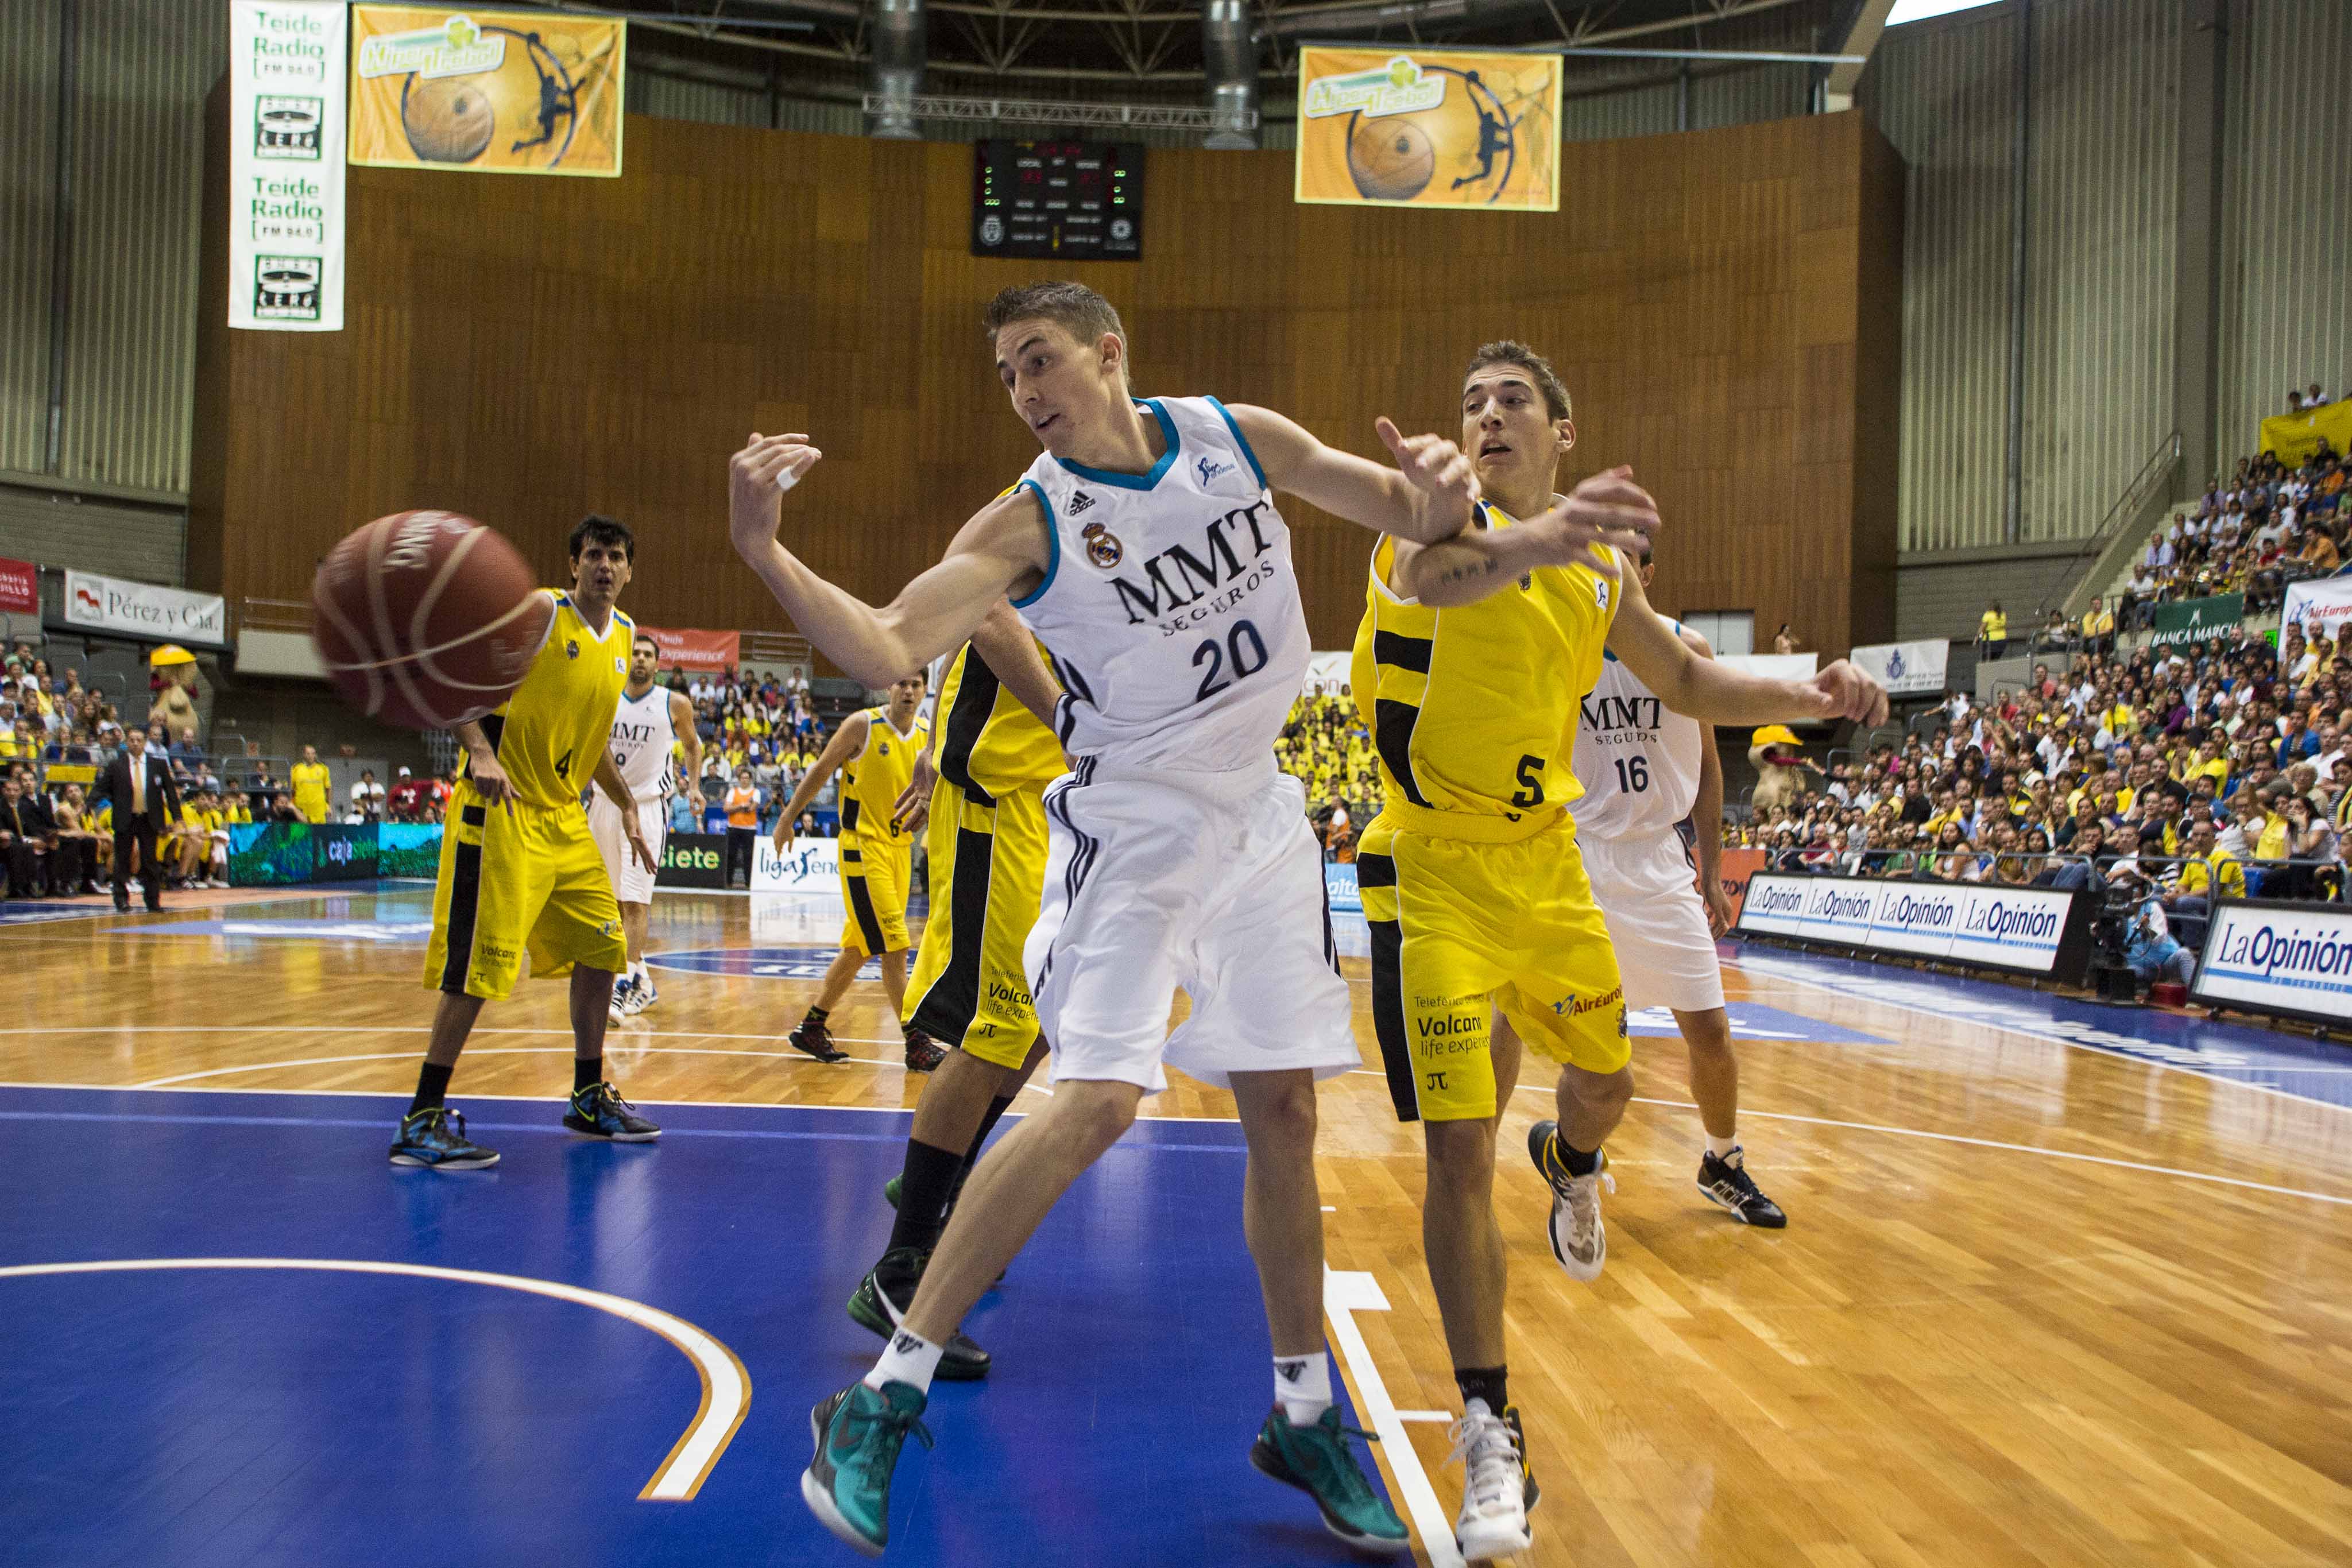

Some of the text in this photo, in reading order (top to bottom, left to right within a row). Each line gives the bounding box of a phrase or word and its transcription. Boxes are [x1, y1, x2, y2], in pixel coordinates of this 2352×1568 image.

[255, 10, 322, 36] Teide
[254, 36, 324, 60] Radio
[252, 176, 320, 199] Teide
[252, 199, 324, 221] Radio
[1070, 498, 1096, 516] adidas
[1105, 499, 1273, 625] MMT
[1159, 559, 1276, 638] SEGUROS
[108, 591, 161, 624] Pérez
[167, 606, 176, 632] y
[2310, 605, 2352, 619] AirEurop
[660, 649, 726, 663] experience
[1192, 620, 1269, 704] 20
[555, 749, 573, 780] 4
[1614, 755, 1649, 793] 16
[1511, 754, 1545, 808] 5
[889, 818, 903, 838] 6
[986, 1000, 1003, 1016] life
[1421, 1038, 1443, 1060] life
